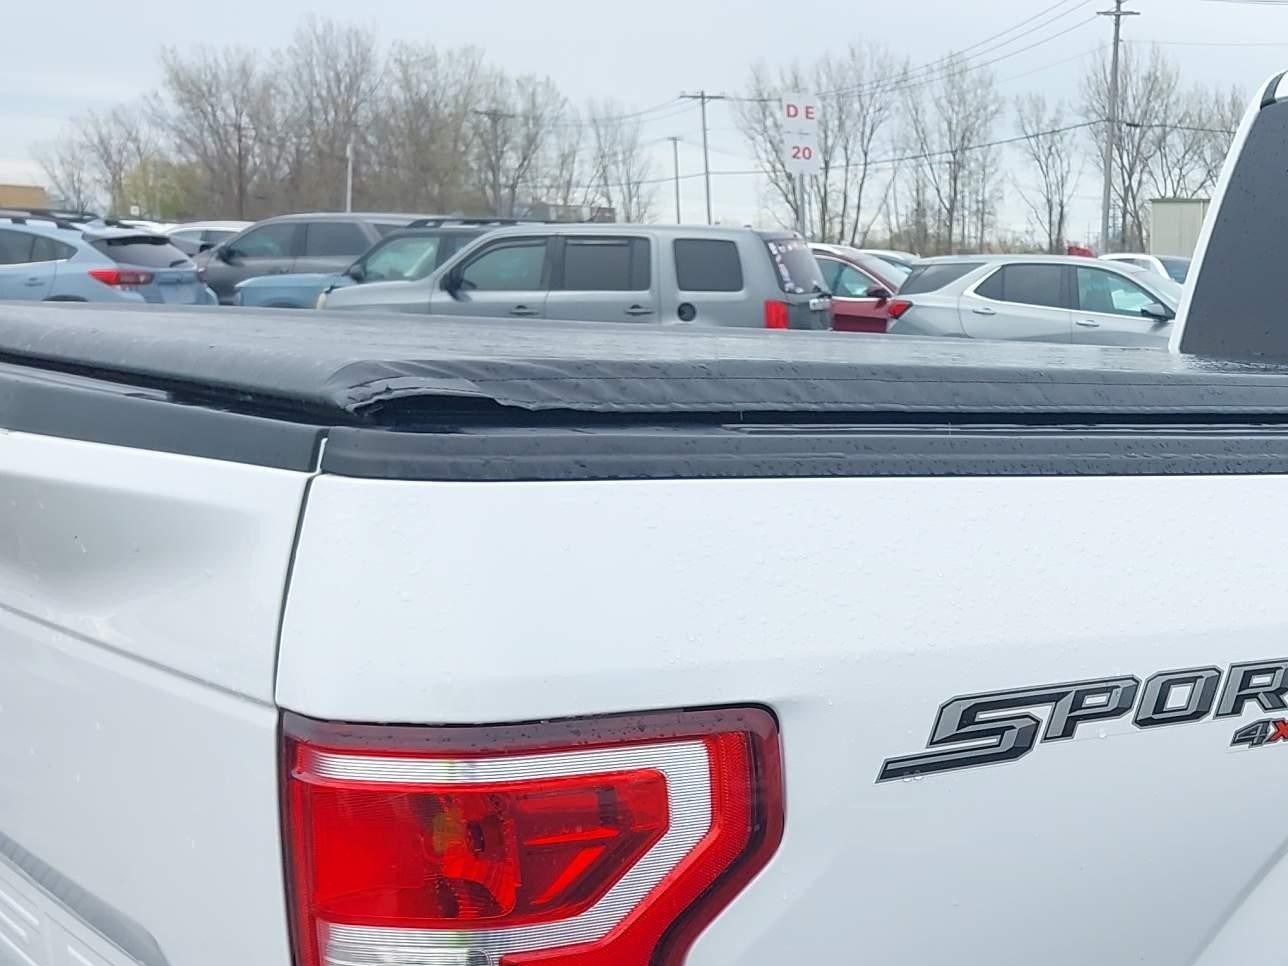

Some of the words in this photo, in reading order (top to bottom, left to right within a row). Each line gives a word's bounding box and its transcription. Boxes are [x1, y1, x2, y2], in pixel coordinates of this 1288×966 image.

[786, 104, 799, 118] D
[805, 106, 815, 120] E
[792, 146, 812, 160] 20
